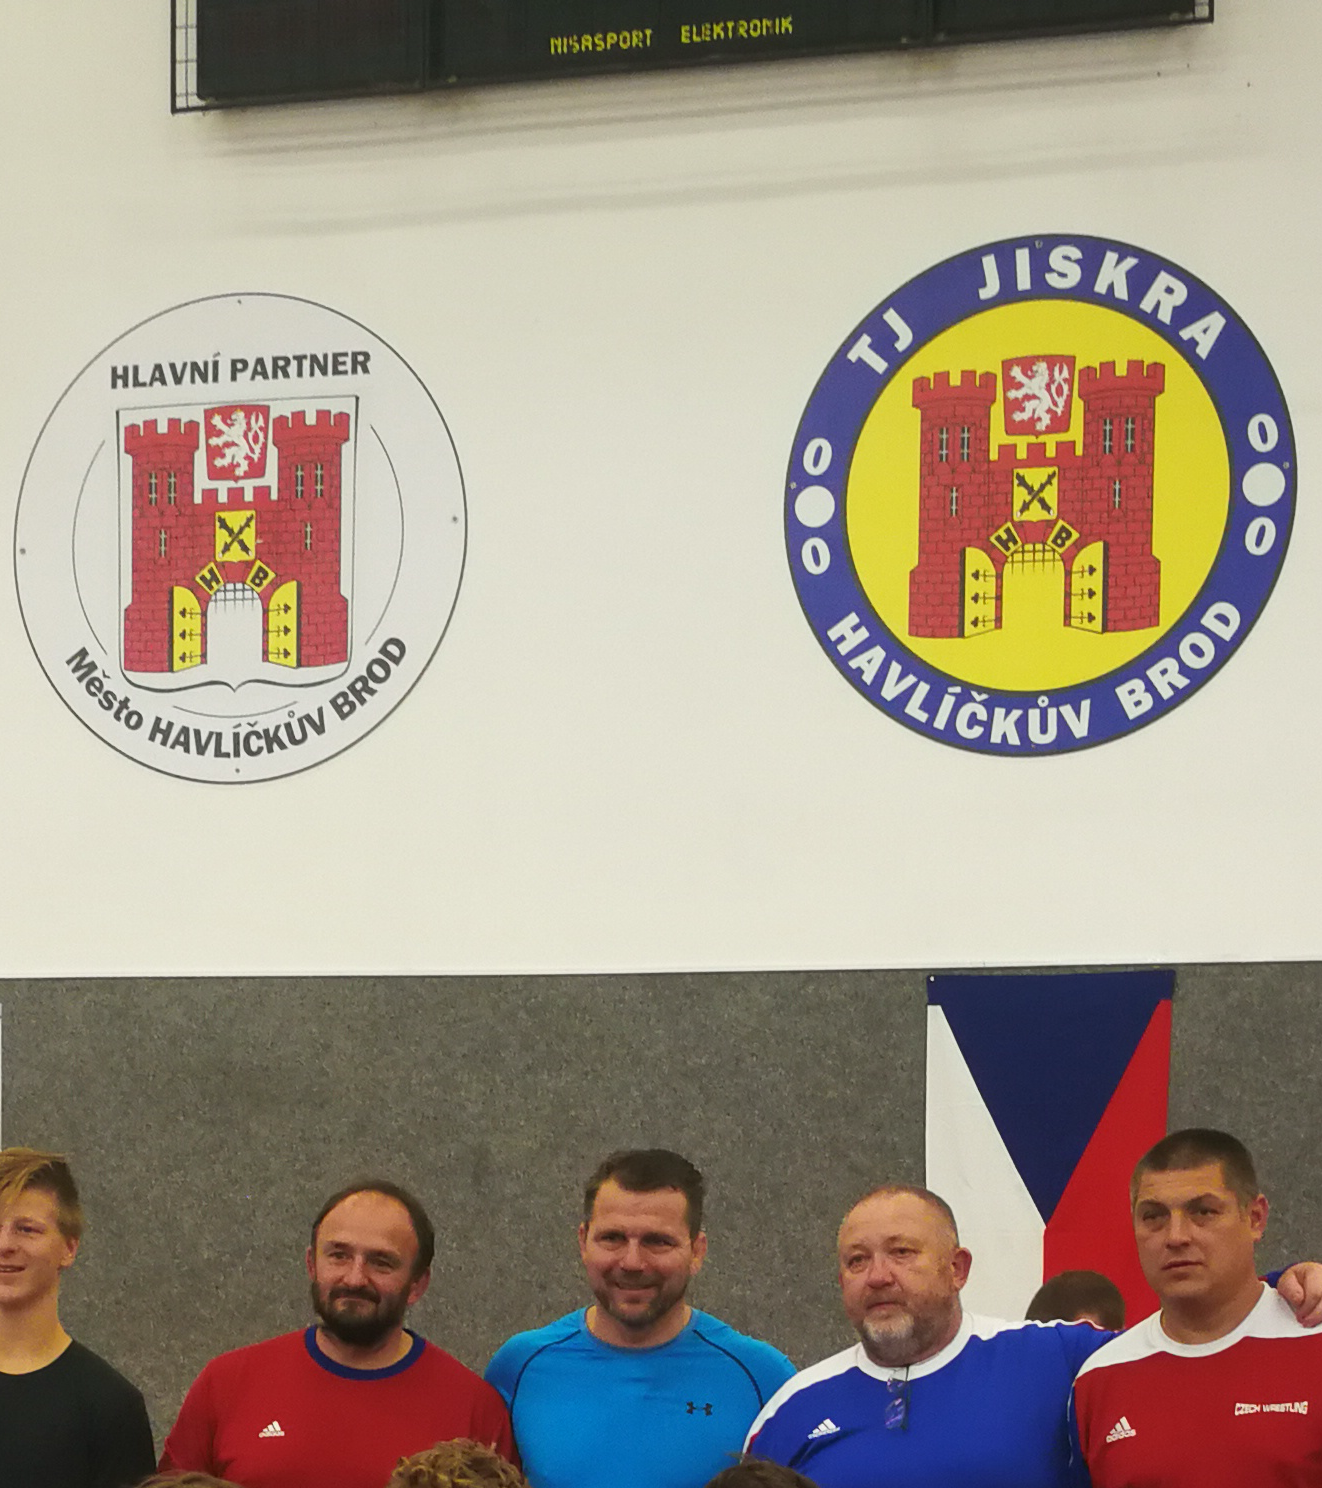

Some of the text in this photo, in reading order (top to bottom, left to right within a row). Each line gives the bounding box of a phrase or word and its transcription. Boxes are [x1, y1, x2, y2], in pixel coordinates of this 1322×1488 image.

[549, 15, 793, 55] NISASPORT ELEKTRONIK
[110, 351, 372, 390] HLAVNÍ PARTNER
[847, 244, 1228, 376] TJ JISKRA
[65, 636, 408, 760] Město HAVLÍČKŮV BROD
[826, 600, 1243, 747] HAVLÍČKŮV BROD
